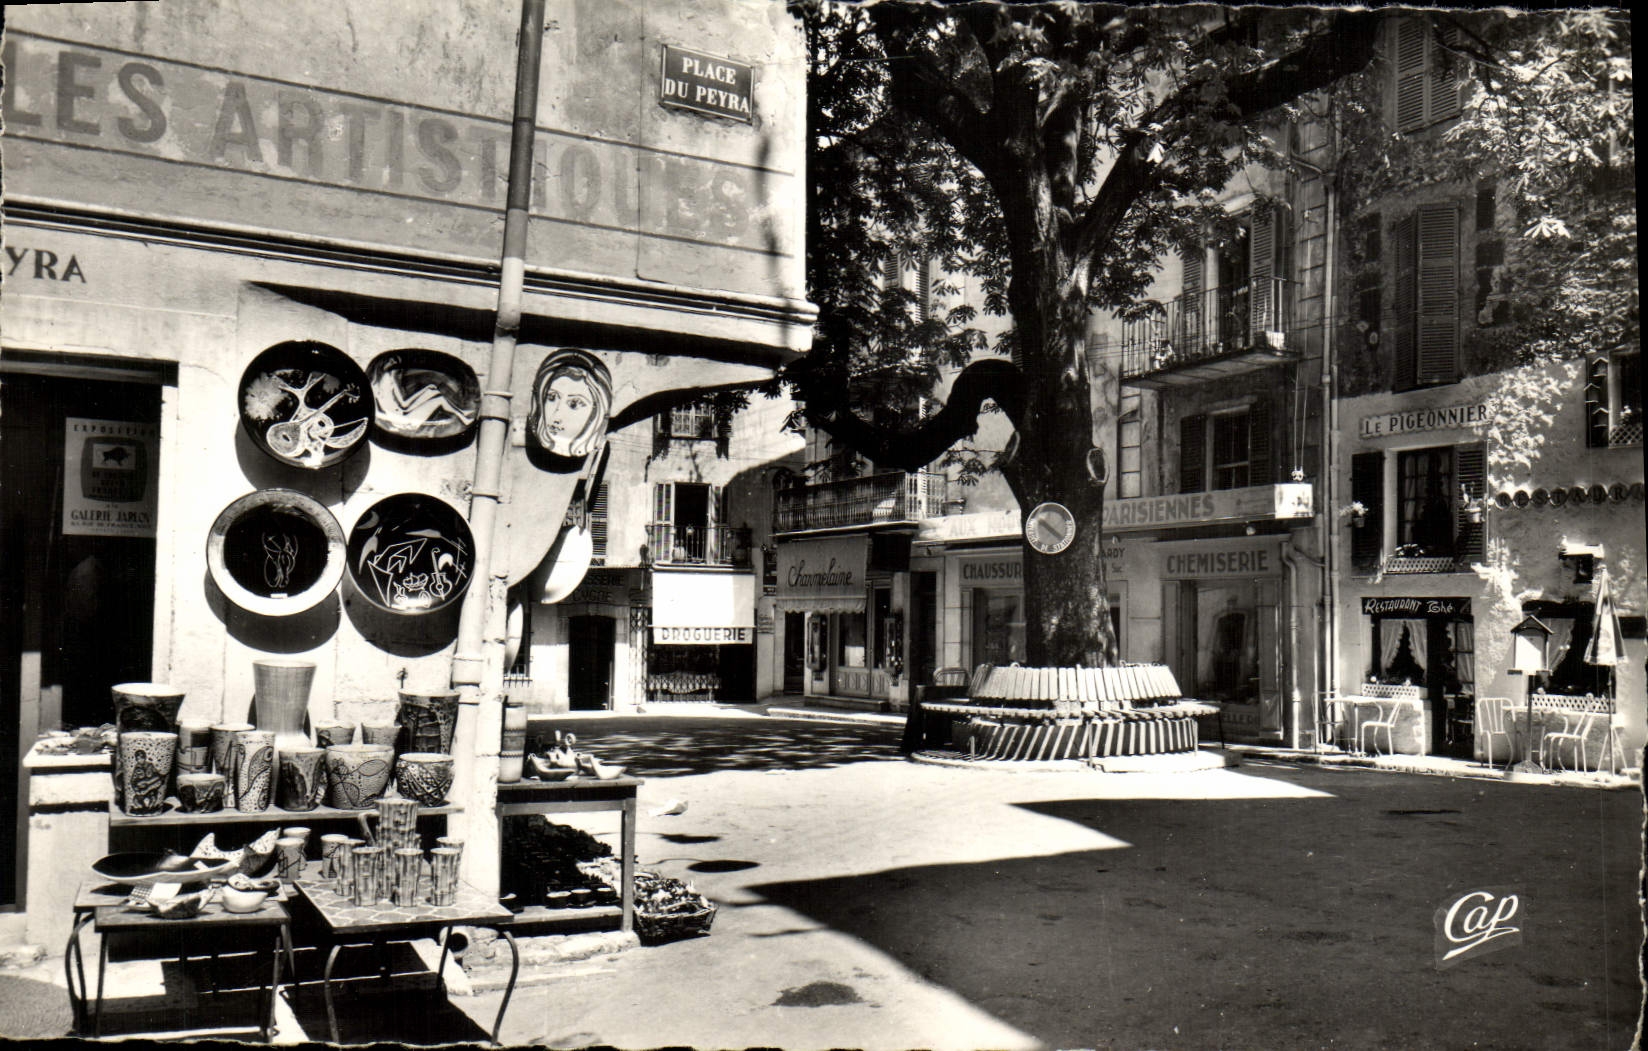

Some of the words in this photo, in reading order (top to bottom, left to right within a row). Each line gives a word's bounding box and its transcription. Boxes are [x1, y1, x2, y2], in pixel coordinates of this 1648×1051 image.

[682, 56, 737, 85] PLACE
[664, 78, 689, 99] DU
[695, 85, 750, 114] PEYRA
[4, 41, 168, 144] LES
[210, 80, 750, 237] ARTISTIQUES
[5, 246, 87, 284] YRA
[1389, 404, 1488, 432] PIGEONNIER
[70, 509, 111, 522] GALERIE
[1166, 549, 1270, 575] CHEMISERIE
[661, 626, 746, 642] DROGUERIE
